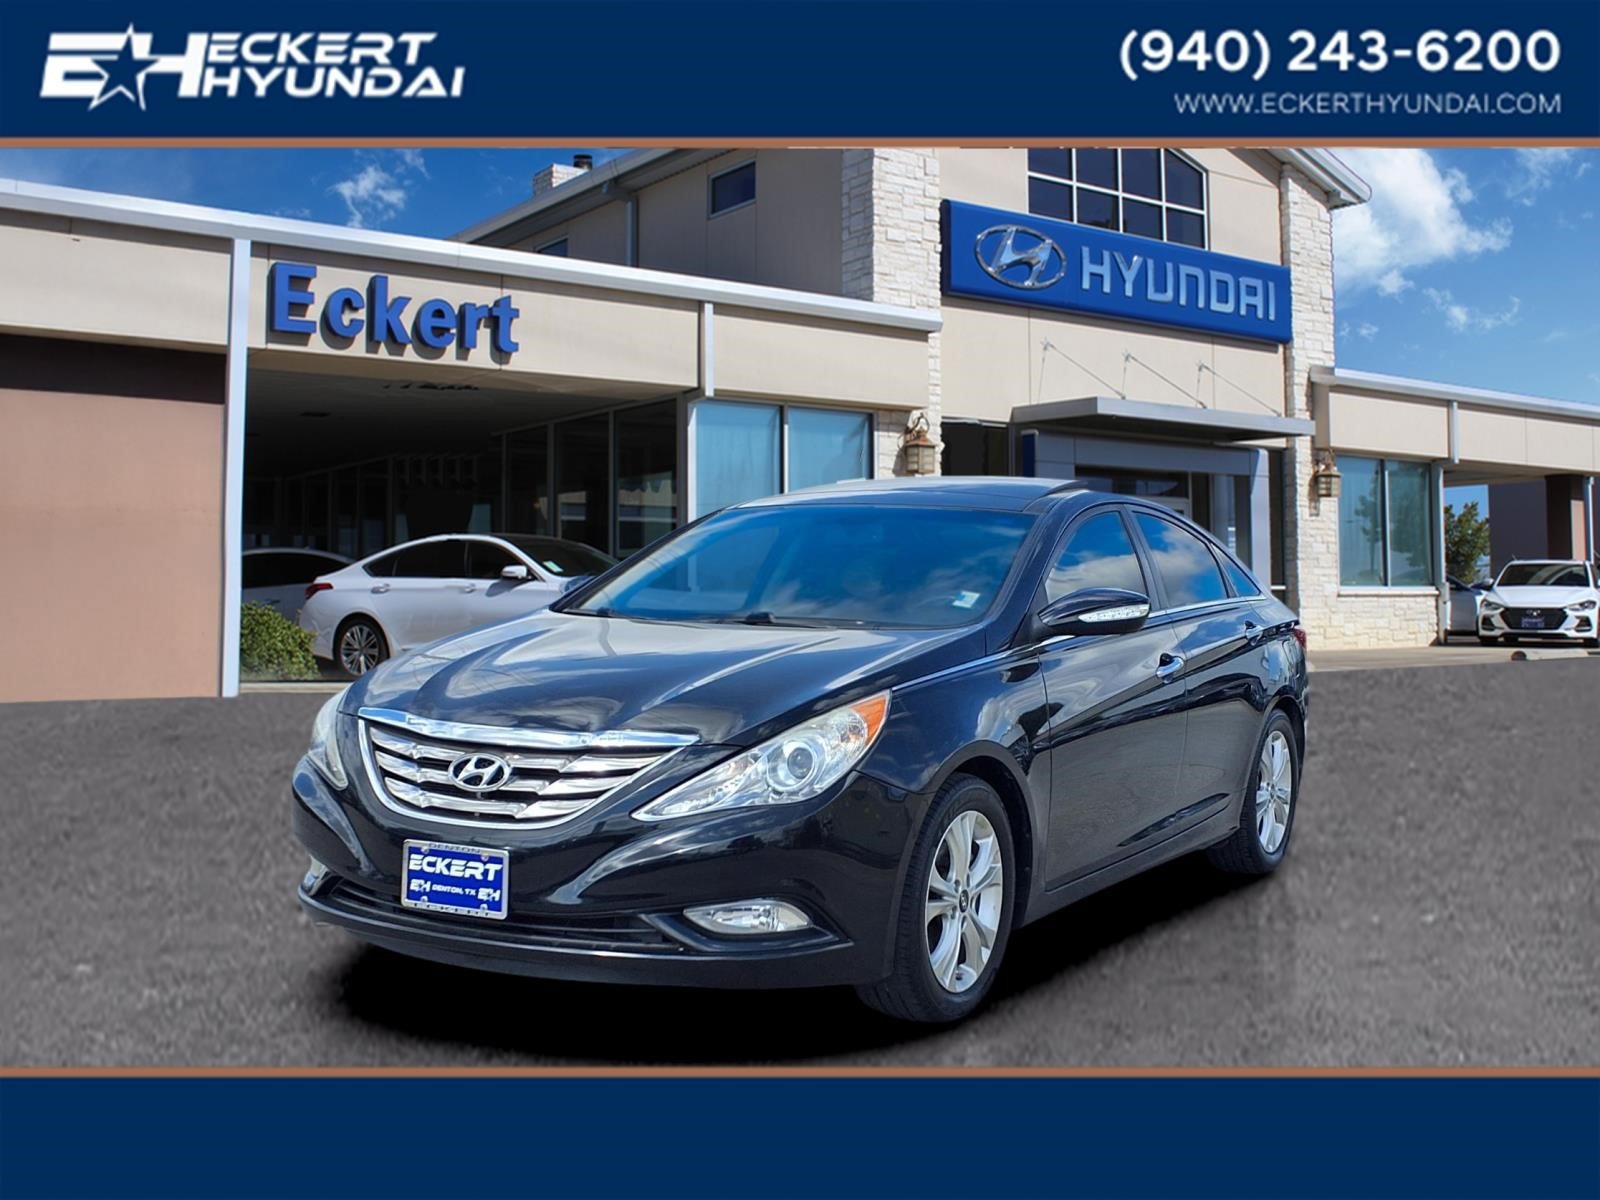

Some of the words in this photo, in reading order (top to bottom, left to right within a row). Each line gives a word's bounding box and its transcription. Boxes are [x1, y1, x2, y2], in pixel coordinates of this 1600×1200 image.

[268, 261, 520, 360] Eckert
[1080, 246, 1276, 322] HYUNDAI
[408, 853, 503, 881] ECKERT
